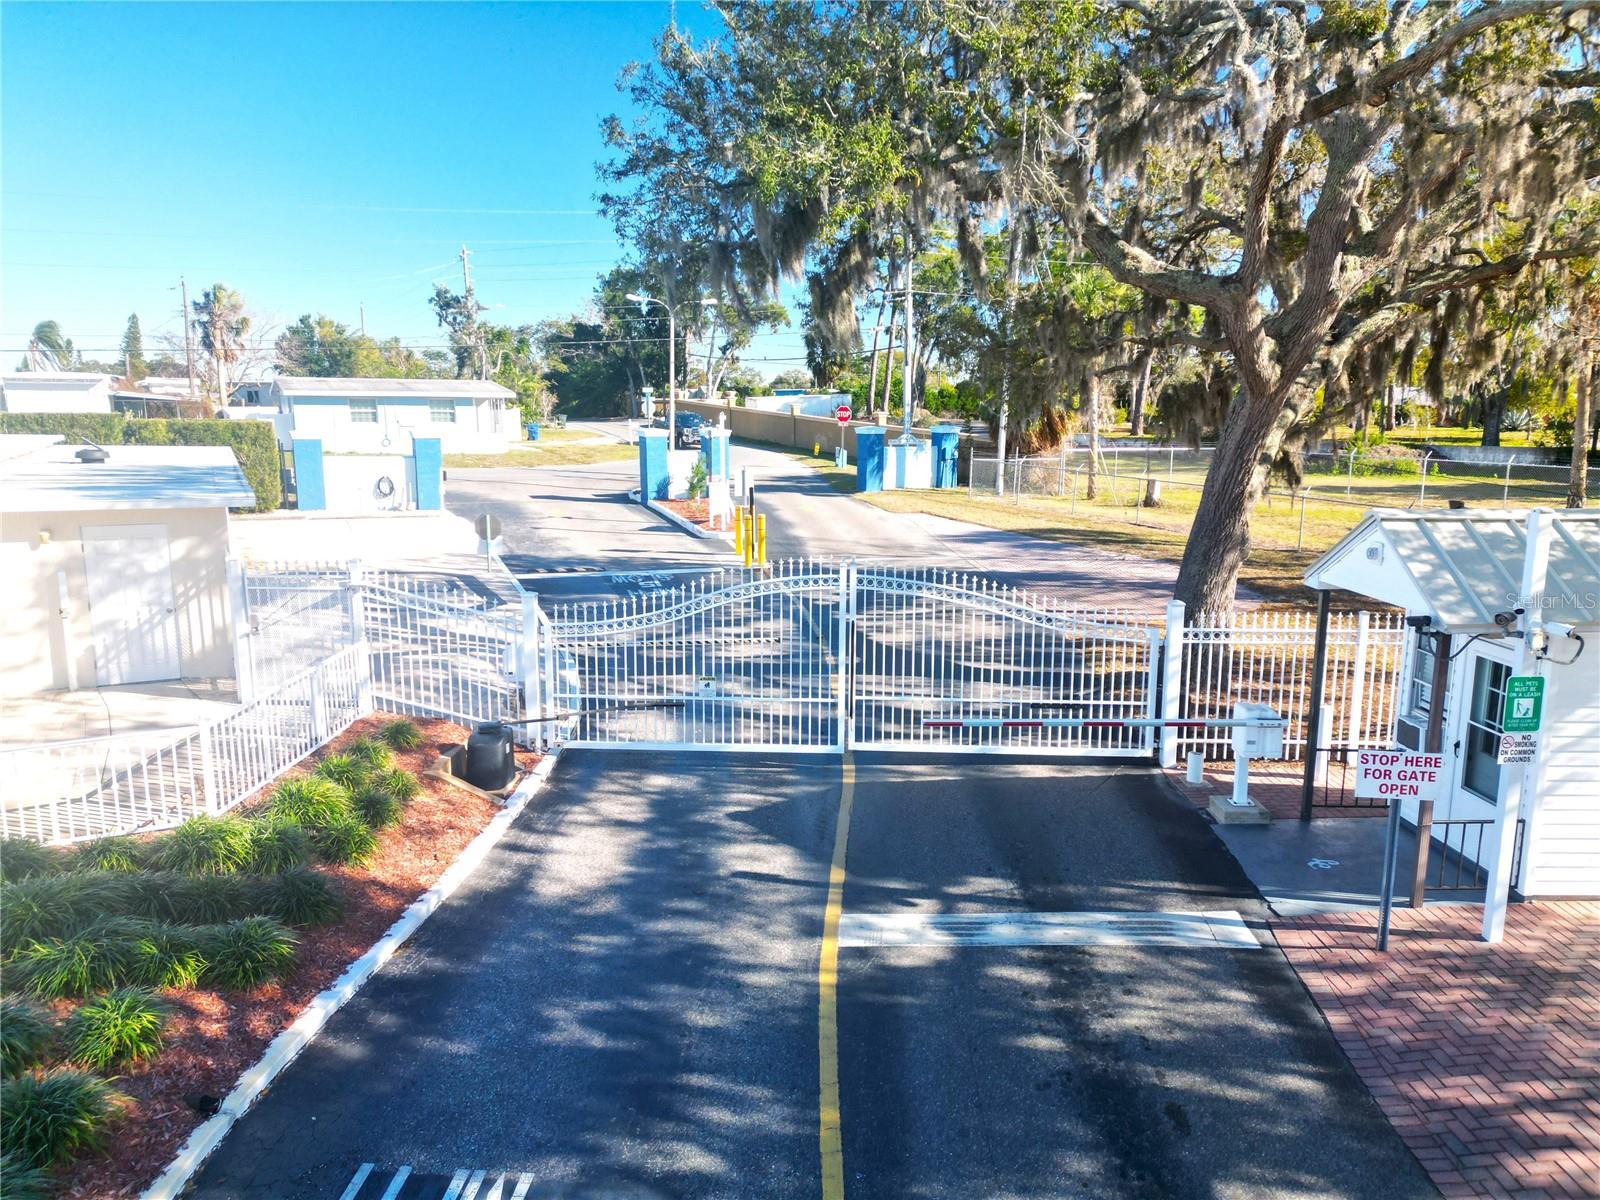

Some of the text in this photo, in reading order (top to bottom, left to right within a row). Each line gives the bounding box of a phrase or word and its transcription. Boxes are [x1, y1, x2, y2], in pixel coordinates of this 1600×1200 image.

[1360, 753, 1442, 768] STOP HERE
[1364, 768, 1437, 782] FOR GATE
[1379, 783, 1419, 795] OPEN
